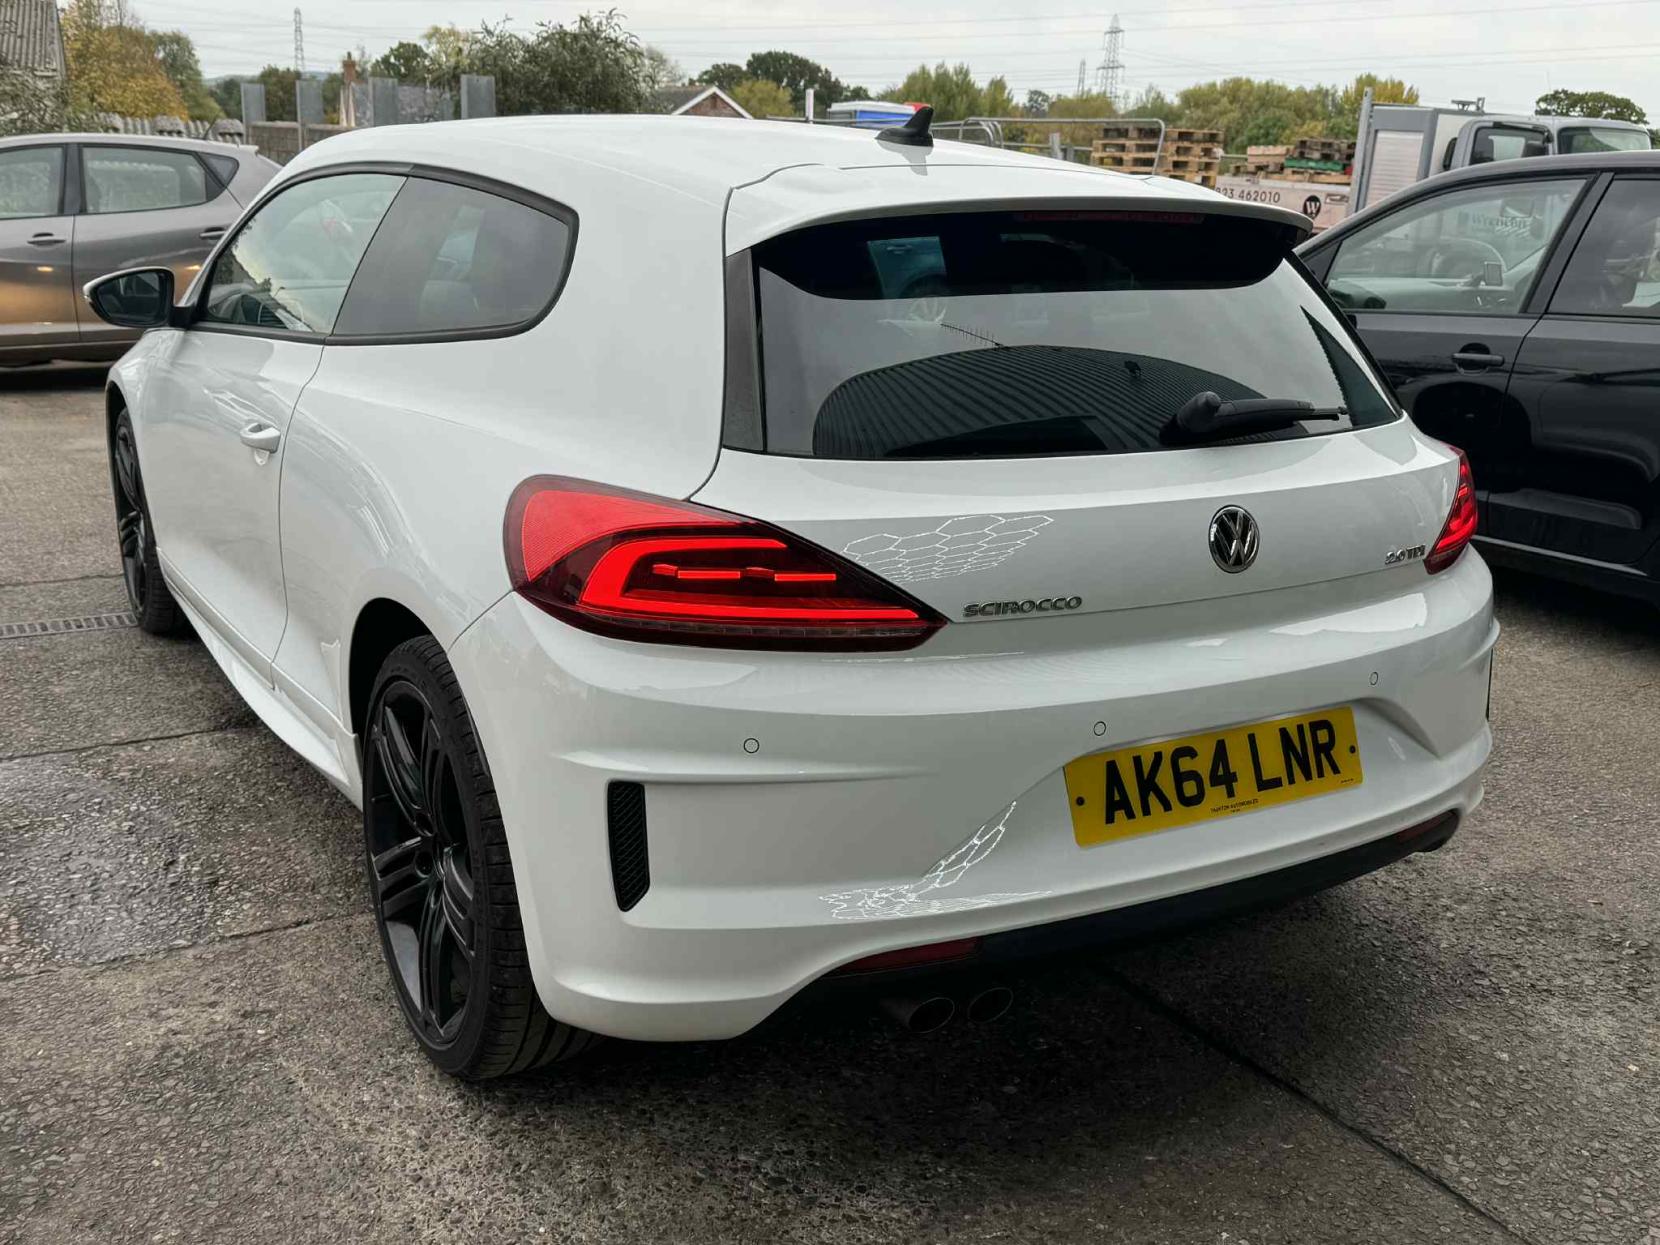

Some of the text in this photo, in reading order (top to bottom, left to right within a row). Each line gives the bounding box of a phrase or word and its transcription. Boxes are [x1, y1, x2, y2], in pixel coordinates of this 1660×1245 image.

[1238, 189, 1281, 203] 462010
[963, 595, 1083, 618] SCIROCCO
[1104, 718, 1341, 825] AK64 LNR
